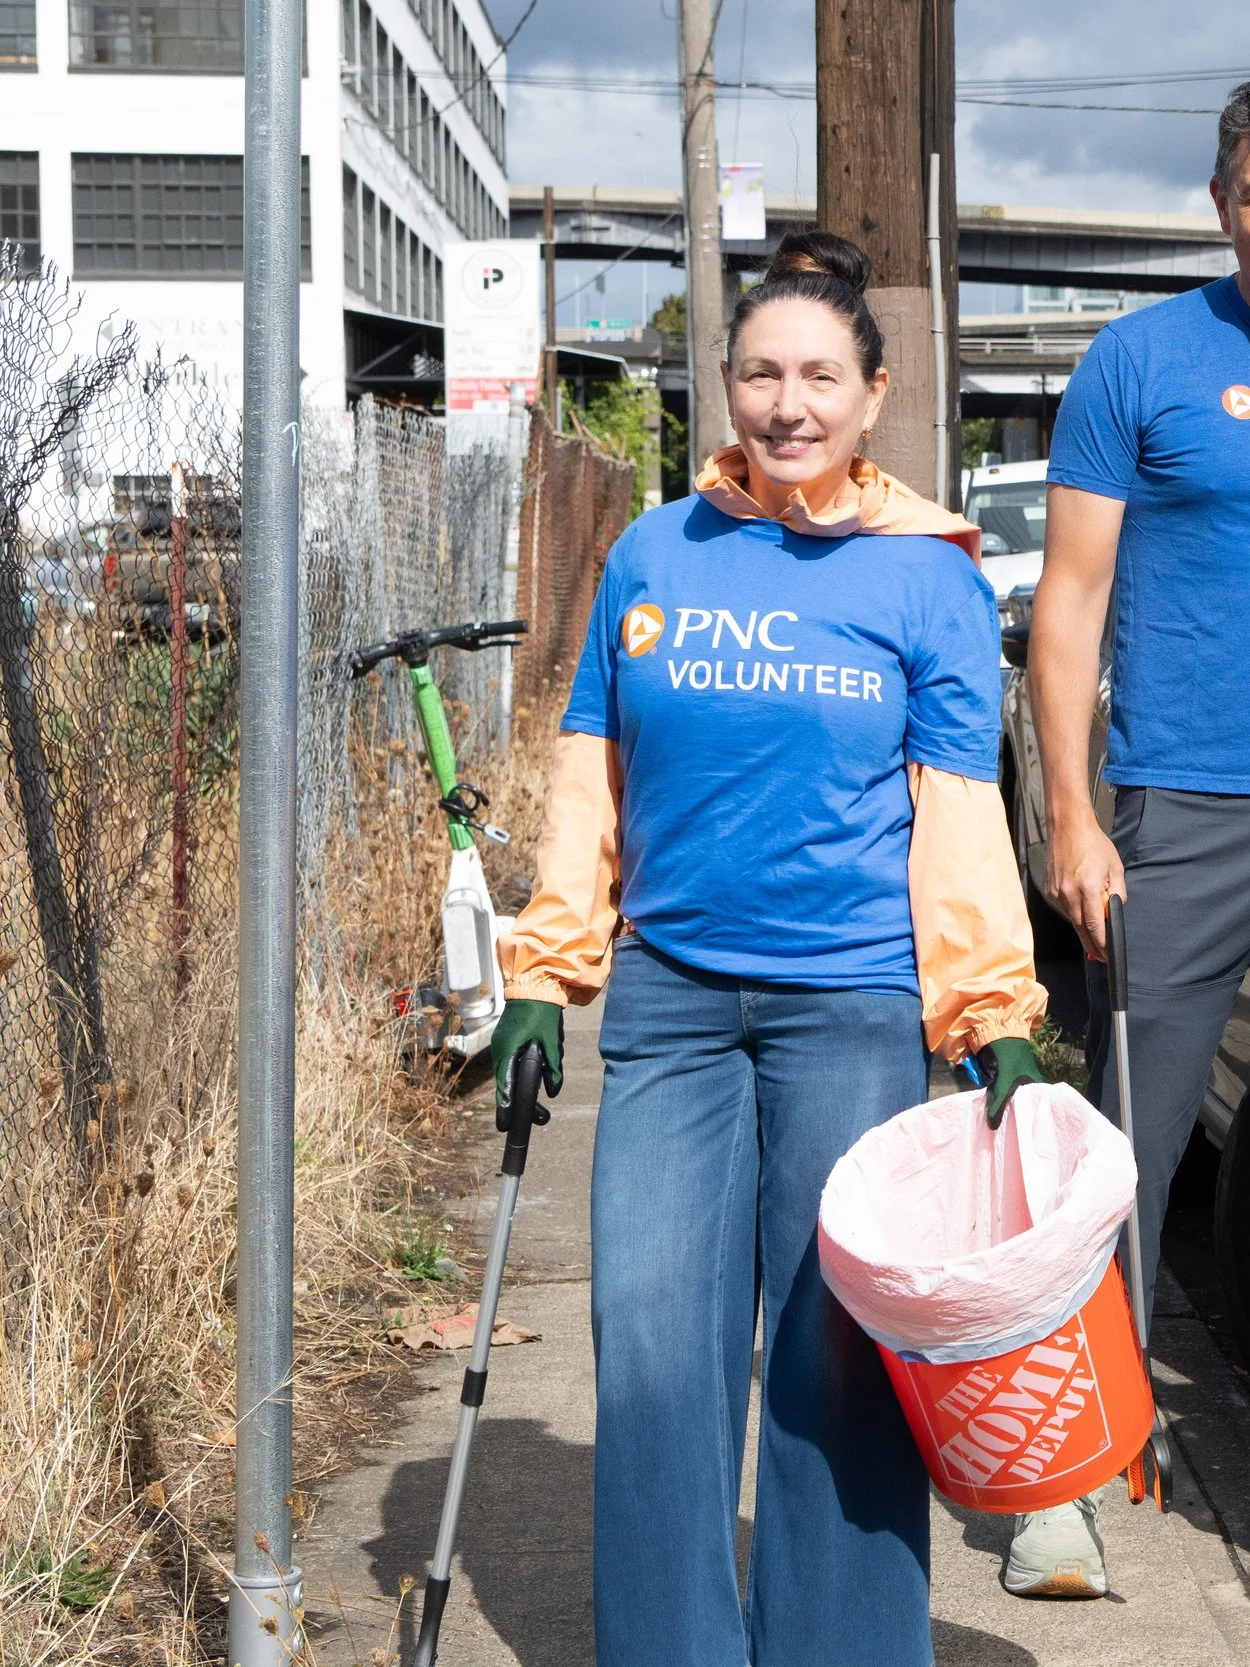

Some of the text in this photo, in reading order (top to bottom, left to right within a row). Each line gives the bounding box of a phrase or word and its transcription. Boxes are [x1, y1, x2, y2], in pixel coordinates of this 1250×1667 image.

[672, 607, 799, 652] PNC
[667, 659, 883, 703] VOLUNTEER
[935, 1366, 1004, 1421] THE
[940, 1332, 1087, 1486] HOME
[1008, 1368, 1096, 1482] DEPOT
